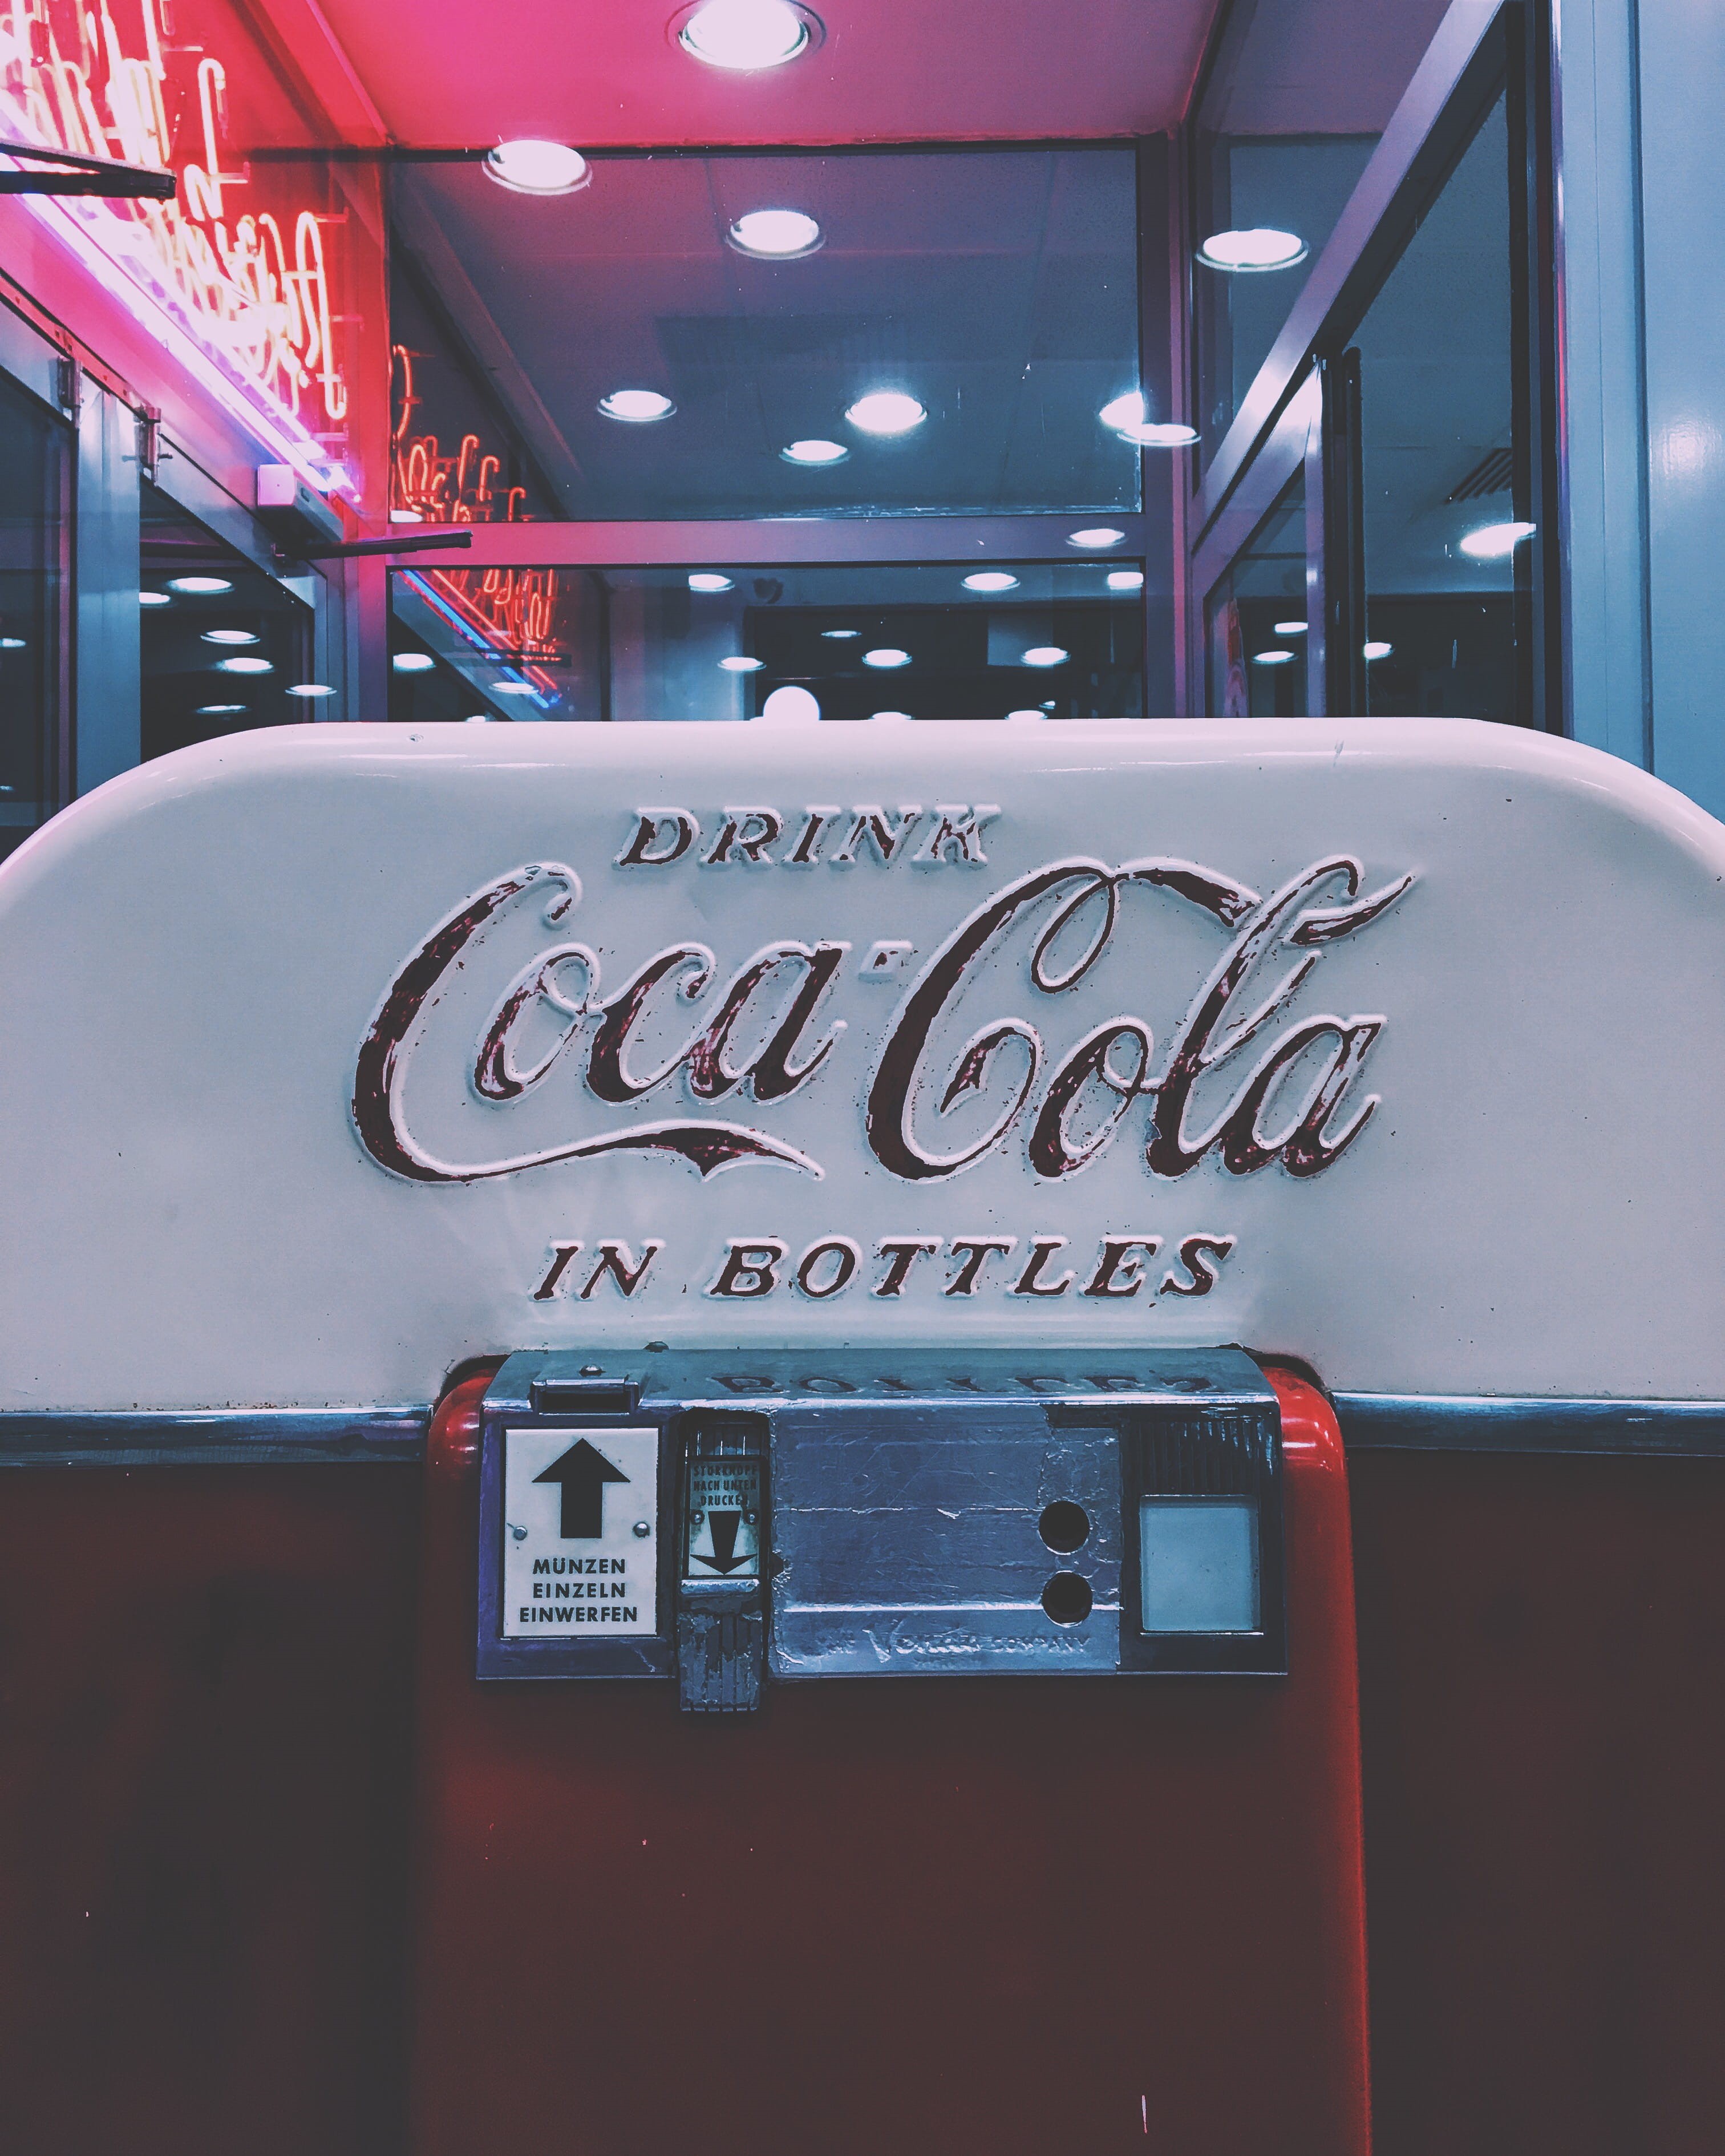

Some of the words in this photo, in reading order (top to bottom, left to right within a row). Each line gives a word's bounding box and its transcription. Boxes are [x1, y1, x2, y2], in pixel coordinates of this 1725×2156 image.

[614, 805, 1002, 870] DRINK
[350, 856, 1420, 1186] Coca-Cola
[529, 1238, 666, 1301] IN
[703, 1234, 1237, 1300] BOTTLES
[532, 1558, 626, 1575] MÜNZEN
[532, 1583, 626, 1599] EINZELN
[519, 1606, 638, 1623] EINWERFEN
